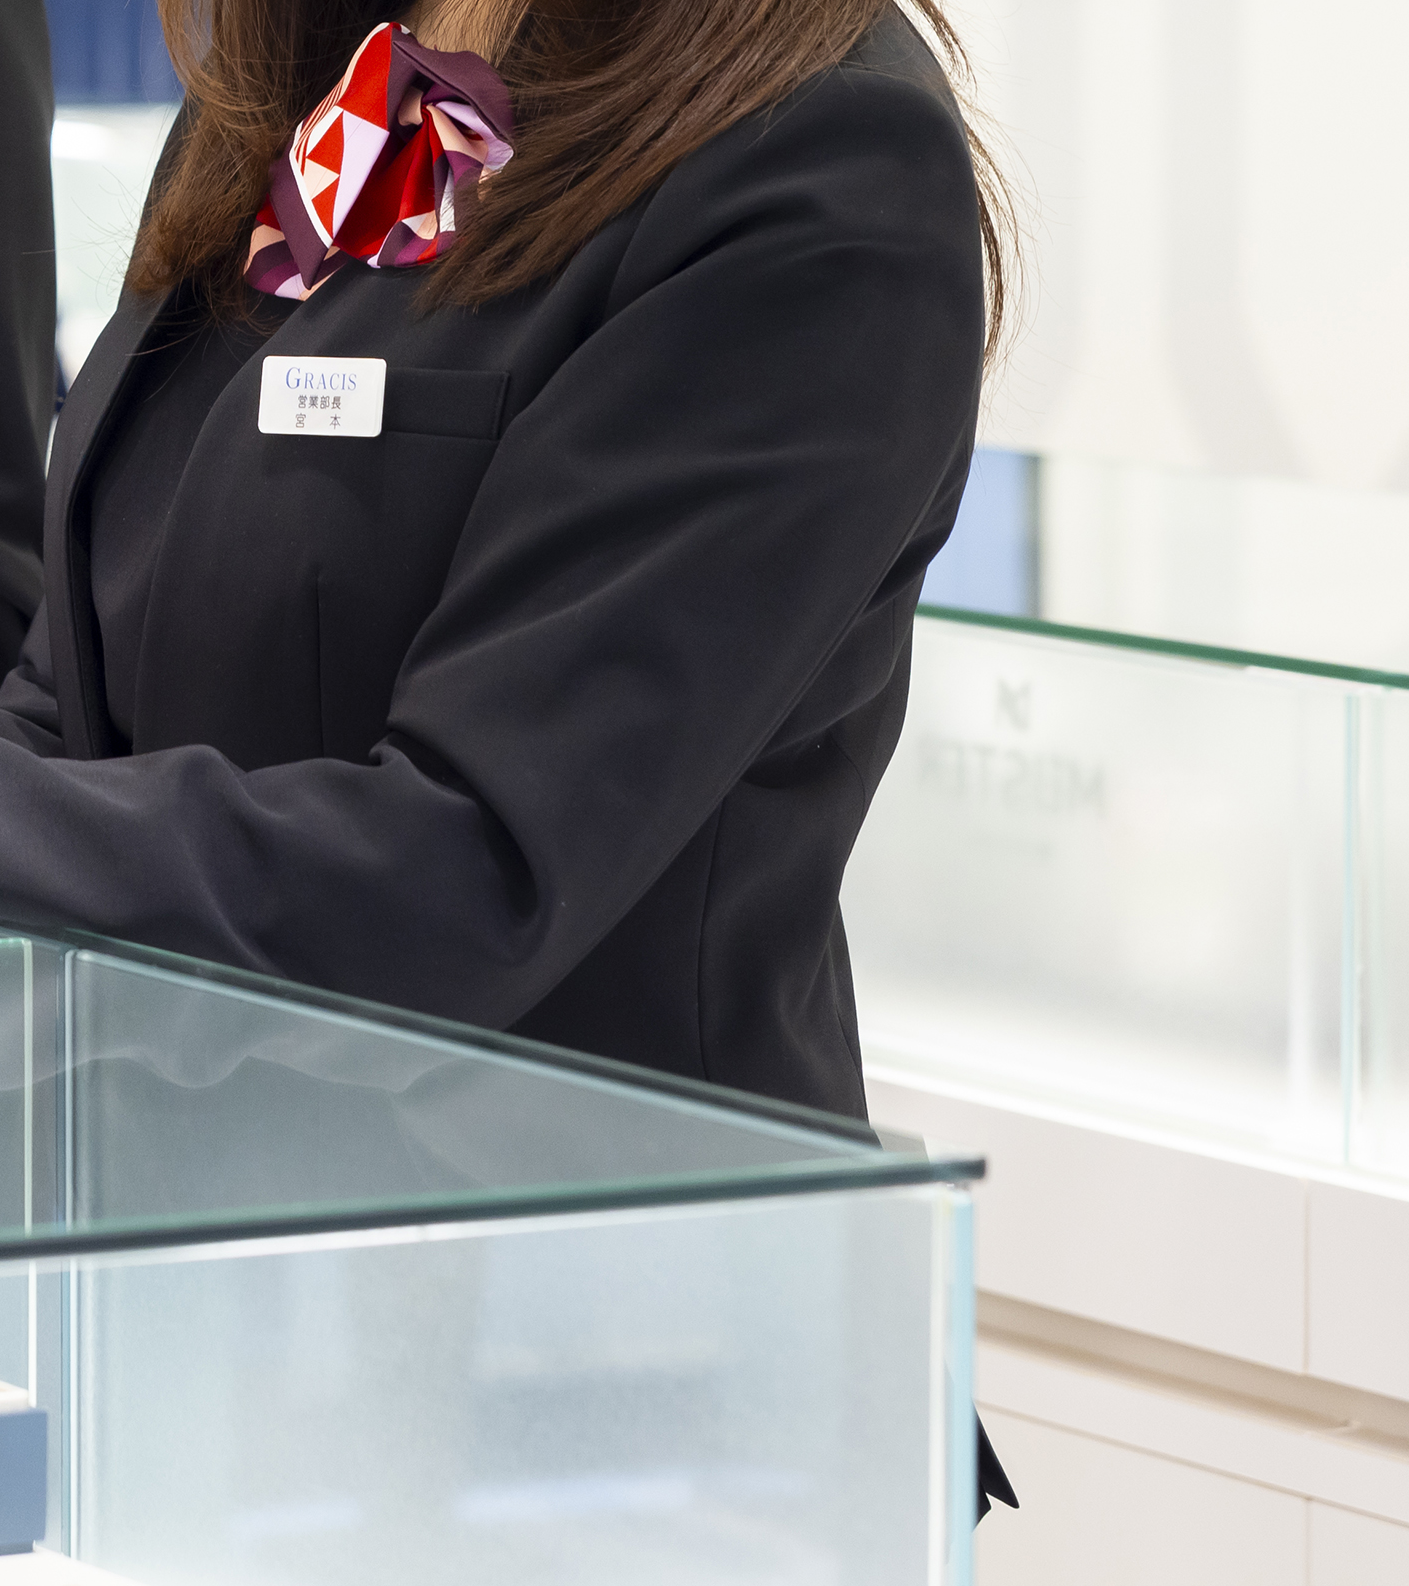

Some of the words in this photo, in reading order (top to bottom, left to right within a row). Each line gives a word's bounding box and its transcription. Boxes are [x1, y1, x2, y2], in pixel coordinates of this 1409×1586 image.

[285, 366, 358, 392] GRACIS
[297, 395, 342, 411] 営業部長
